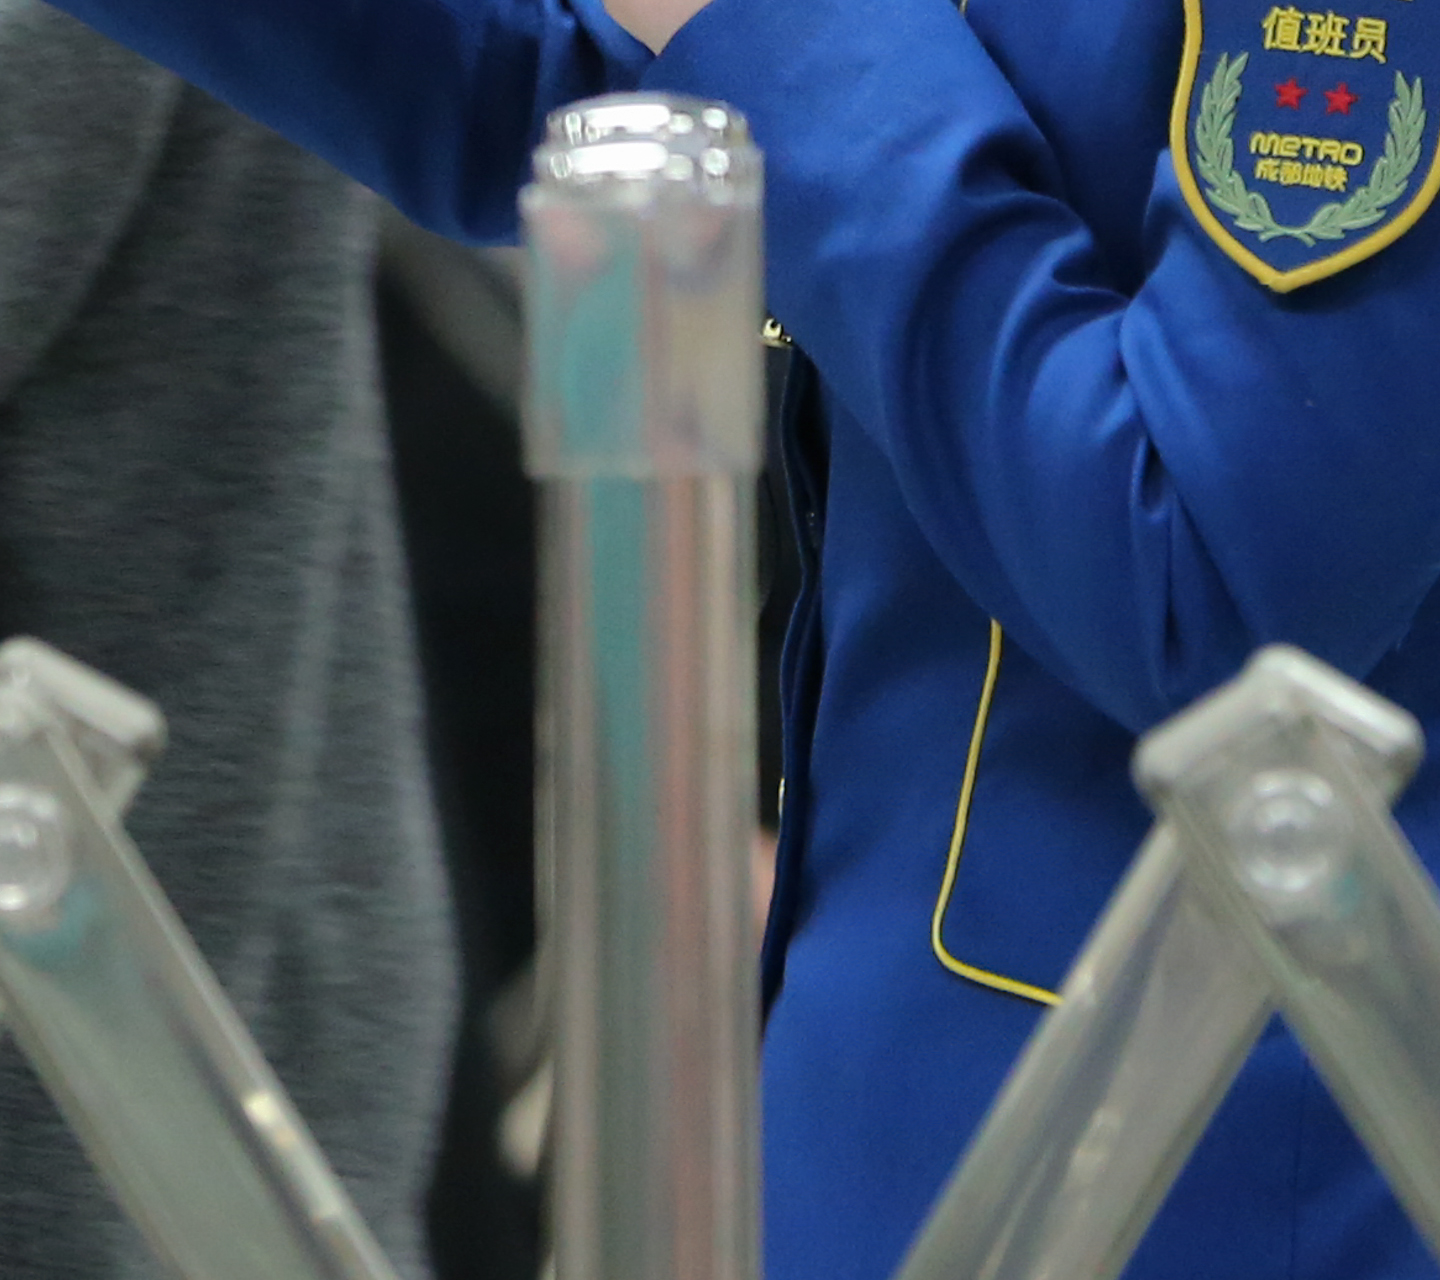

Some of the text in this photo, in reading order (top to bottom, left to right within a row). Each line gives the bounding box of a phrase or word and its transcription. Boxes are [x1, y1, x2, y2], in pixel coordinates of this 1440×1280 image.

[1261, 6, 1387, 64] 值班员
[1249, 130, 1364, 166] METRO
[1255, 158, 1349, 193] 成都地铁
